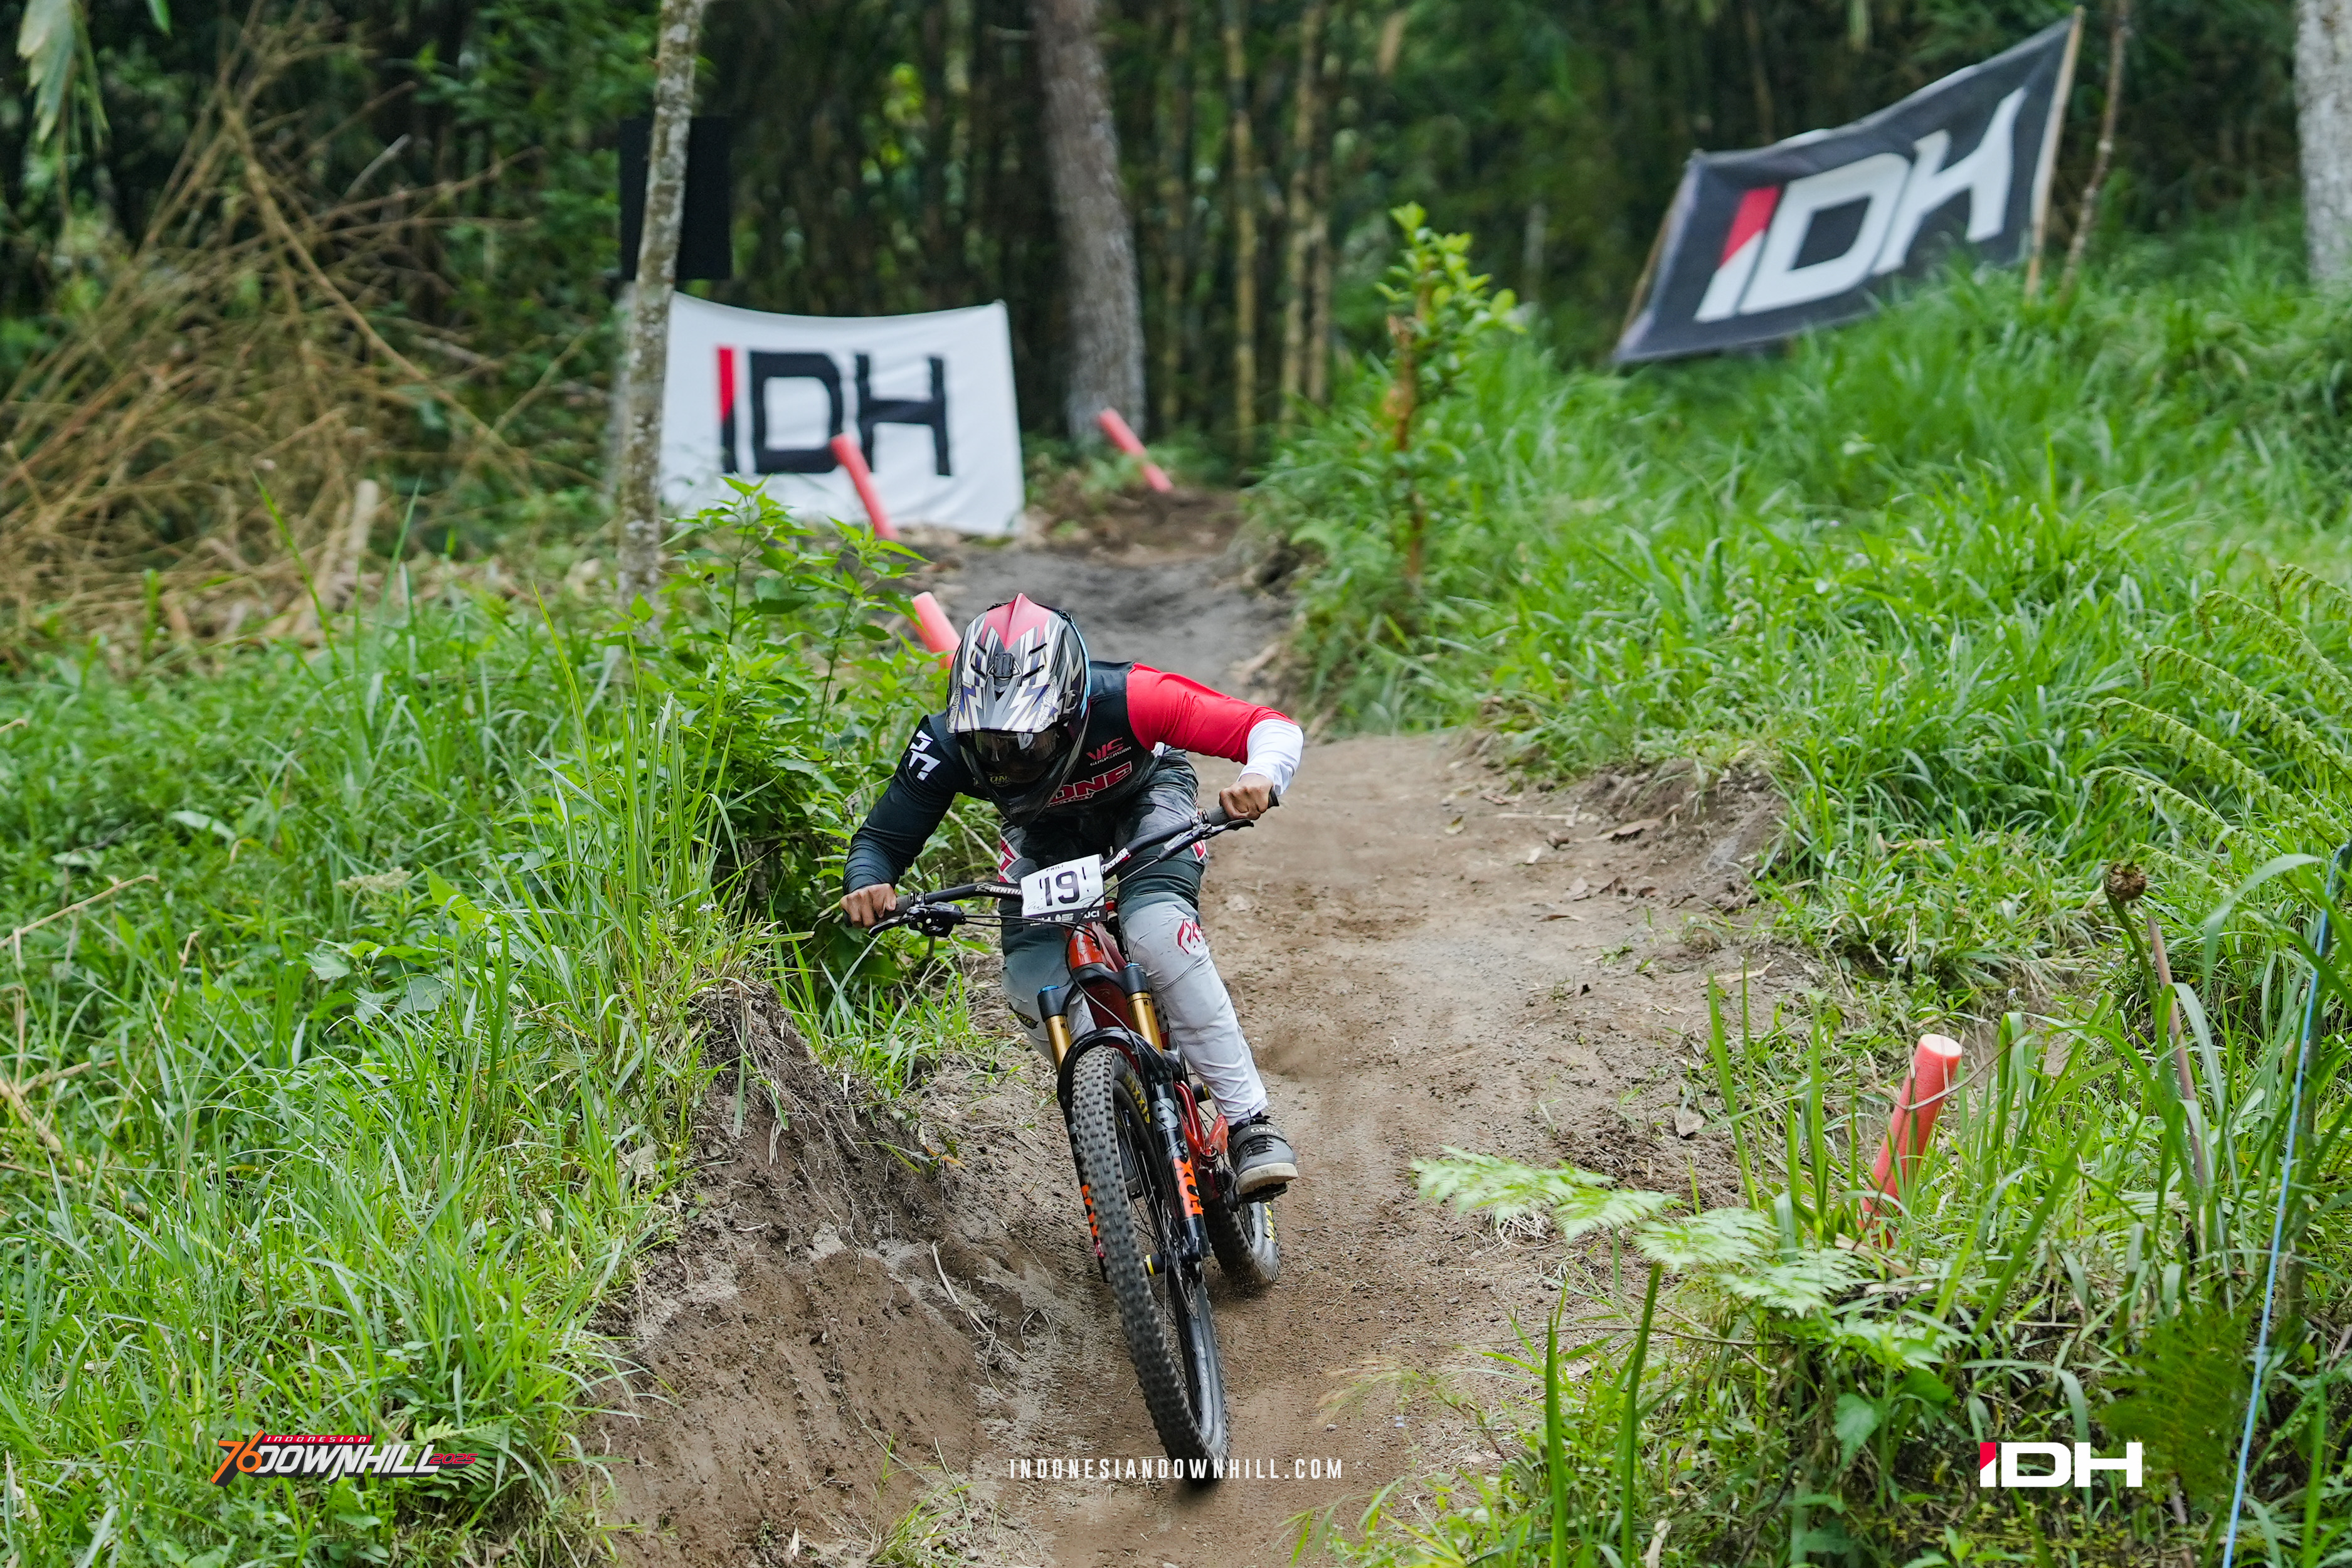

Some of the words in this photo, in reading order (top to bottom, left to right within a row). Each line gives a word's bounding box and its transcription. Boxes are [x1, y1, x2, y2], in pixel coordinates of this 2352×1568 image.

[1694, 87, 2028, 323] IDH
[715, 345, 952, 477] IDH
[989, 886, 1023, 896] RENTHA
[1172, 1157, 1204, 1218] FOX
